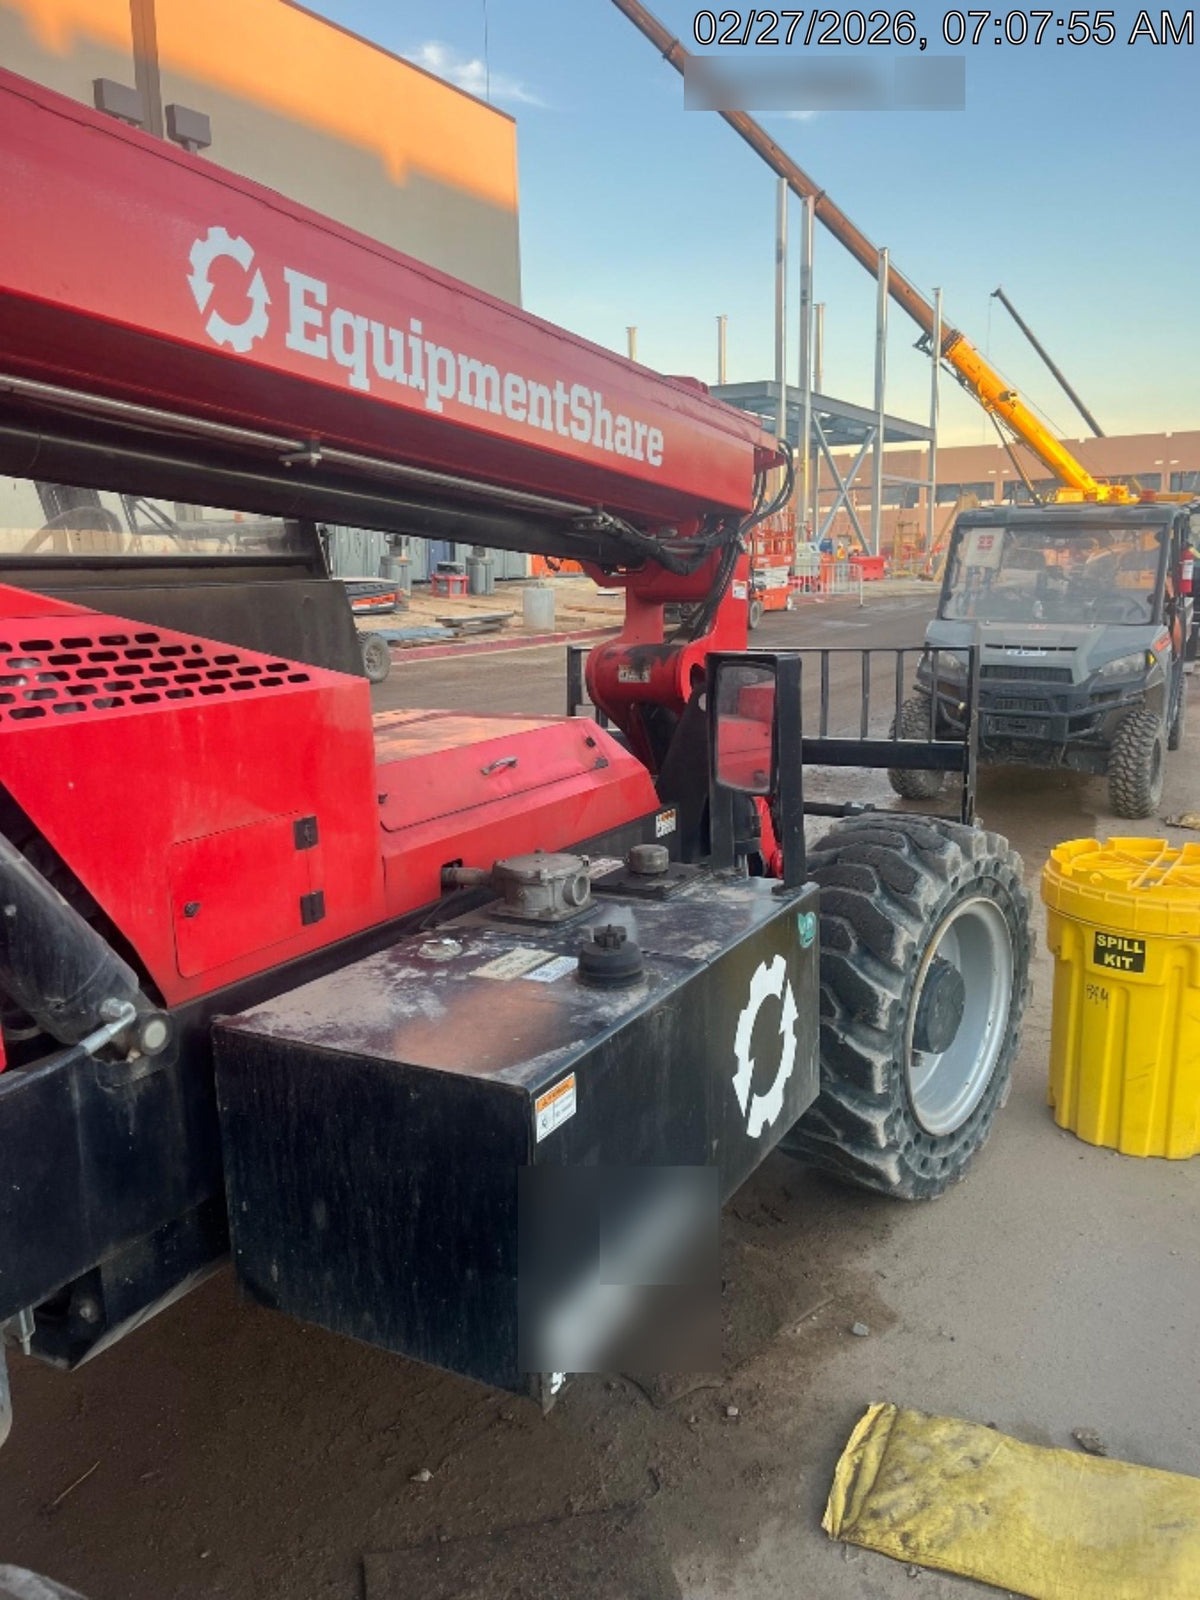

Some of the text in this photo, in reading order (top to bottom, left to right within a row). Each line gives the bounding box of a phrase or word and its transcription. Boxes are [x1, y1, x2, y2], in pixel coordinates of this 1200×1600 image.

[284, 267, 664, 467] EquipmentShare
[1097, 935, 1143, 953] SPILL
[1104, 953, 1133, 969] KIT
